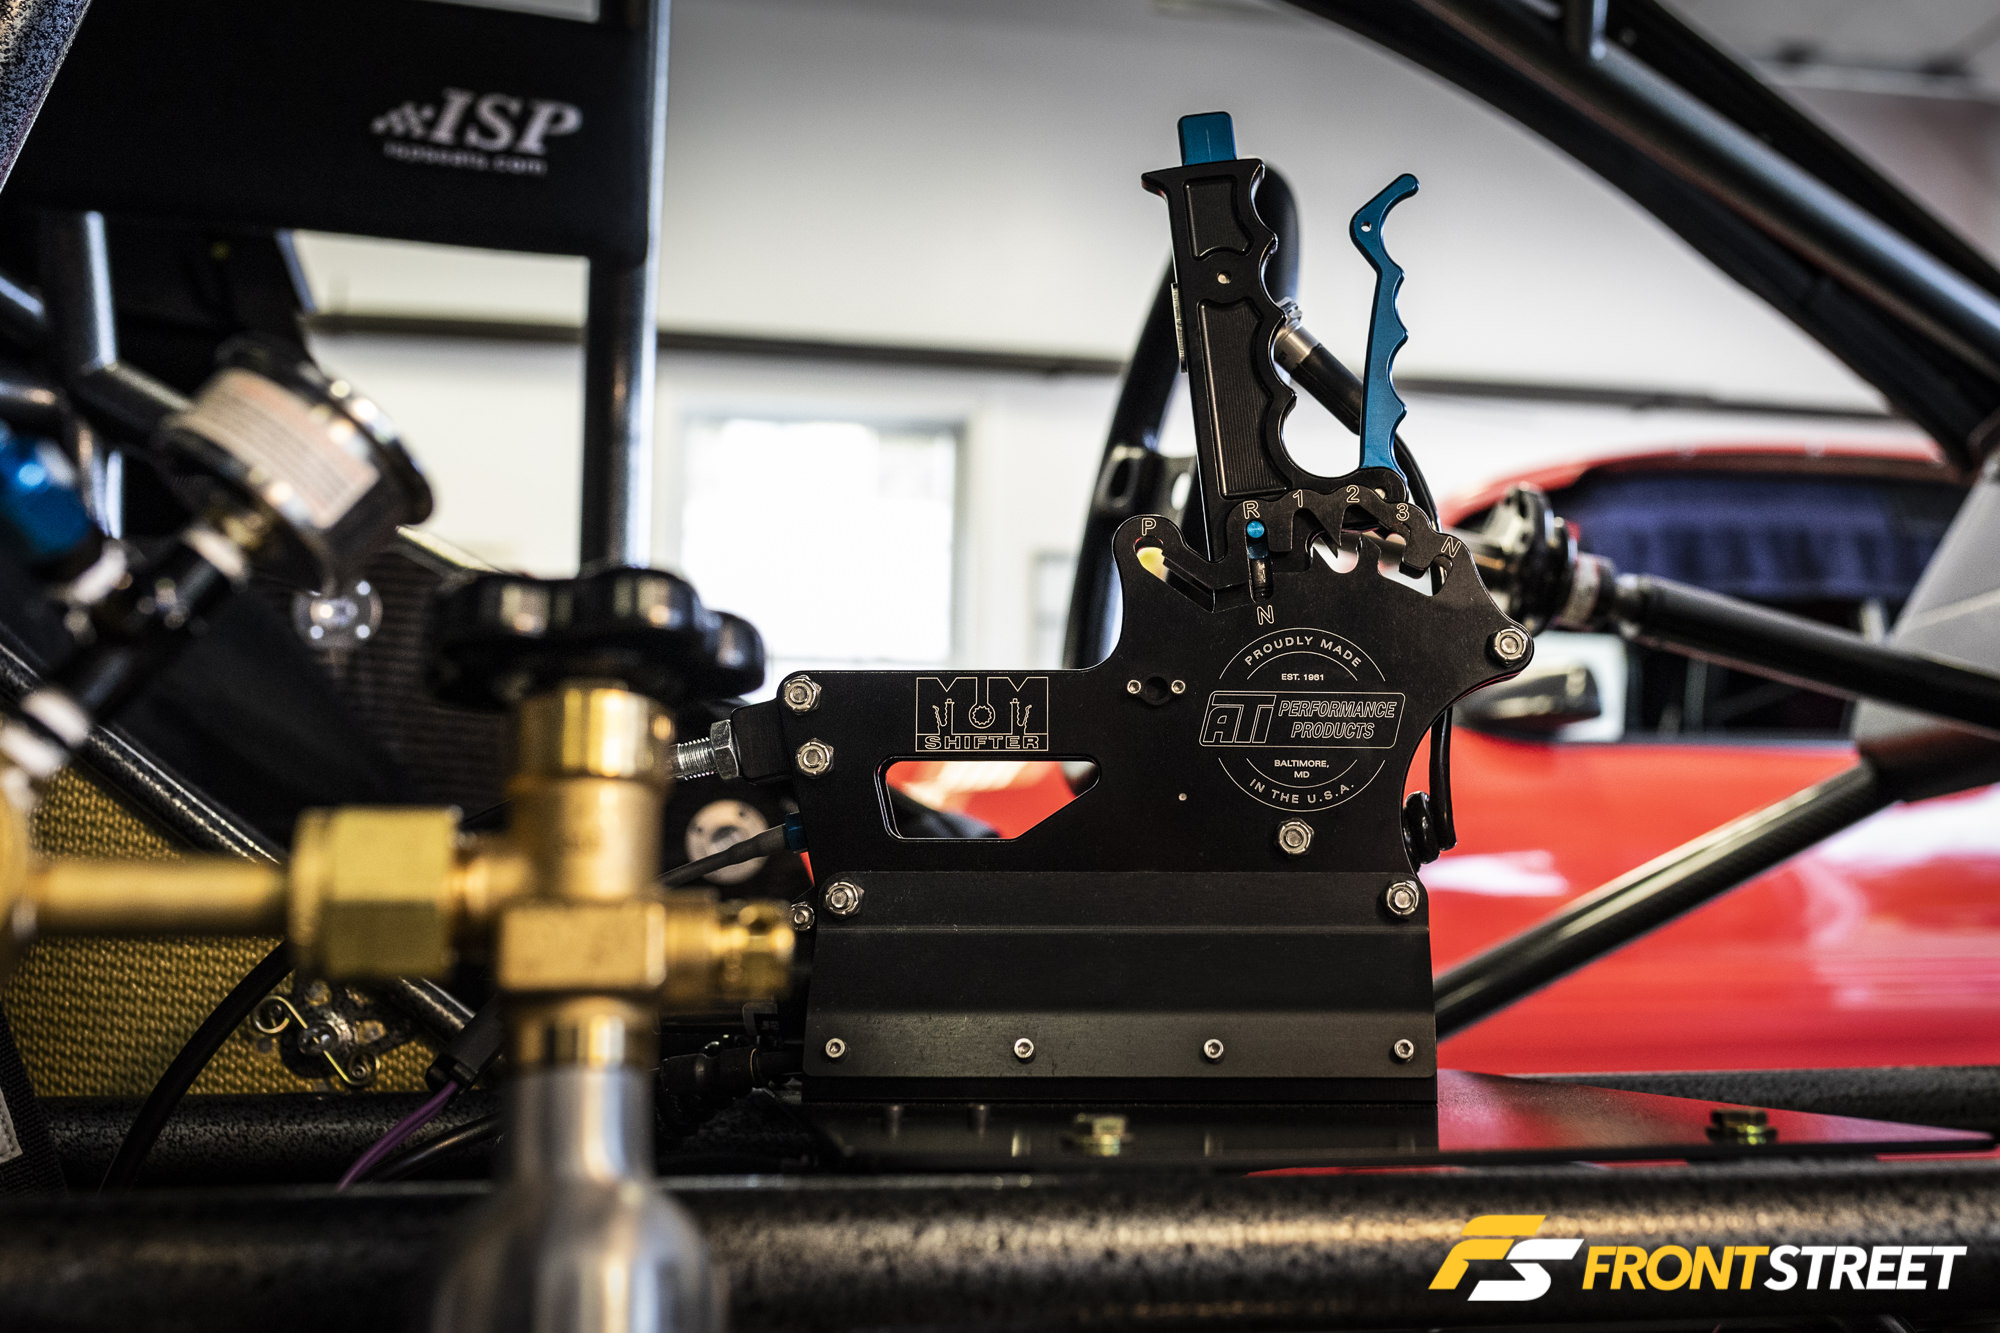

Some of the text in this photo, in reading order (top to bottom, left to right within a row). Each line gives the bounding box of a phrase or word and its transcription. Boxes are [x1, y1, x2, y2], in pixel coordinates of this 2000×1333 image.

[429, 87, 583, 156] ISP
[1141, 485, 1462, 558] P R 1 2 3 N
[1256, 604, 1276, 625] N
[1244, 636, 1362, 668] PROUDLY MADE
[1281, 673, 1324, 681] EST. 1961
[1202, 694, 1398, 744] ATI PERFORMANCE
[1290, 721, 1376, 740] PRODUCTS
[924, 735, 1040, 750] SHIFTER
[1273, 759, 1330, 769] BALTIMORE,
[1293, 771, 1310, 779] MD
[1249, 778, 1355, 804] IN THE U.S.A.
